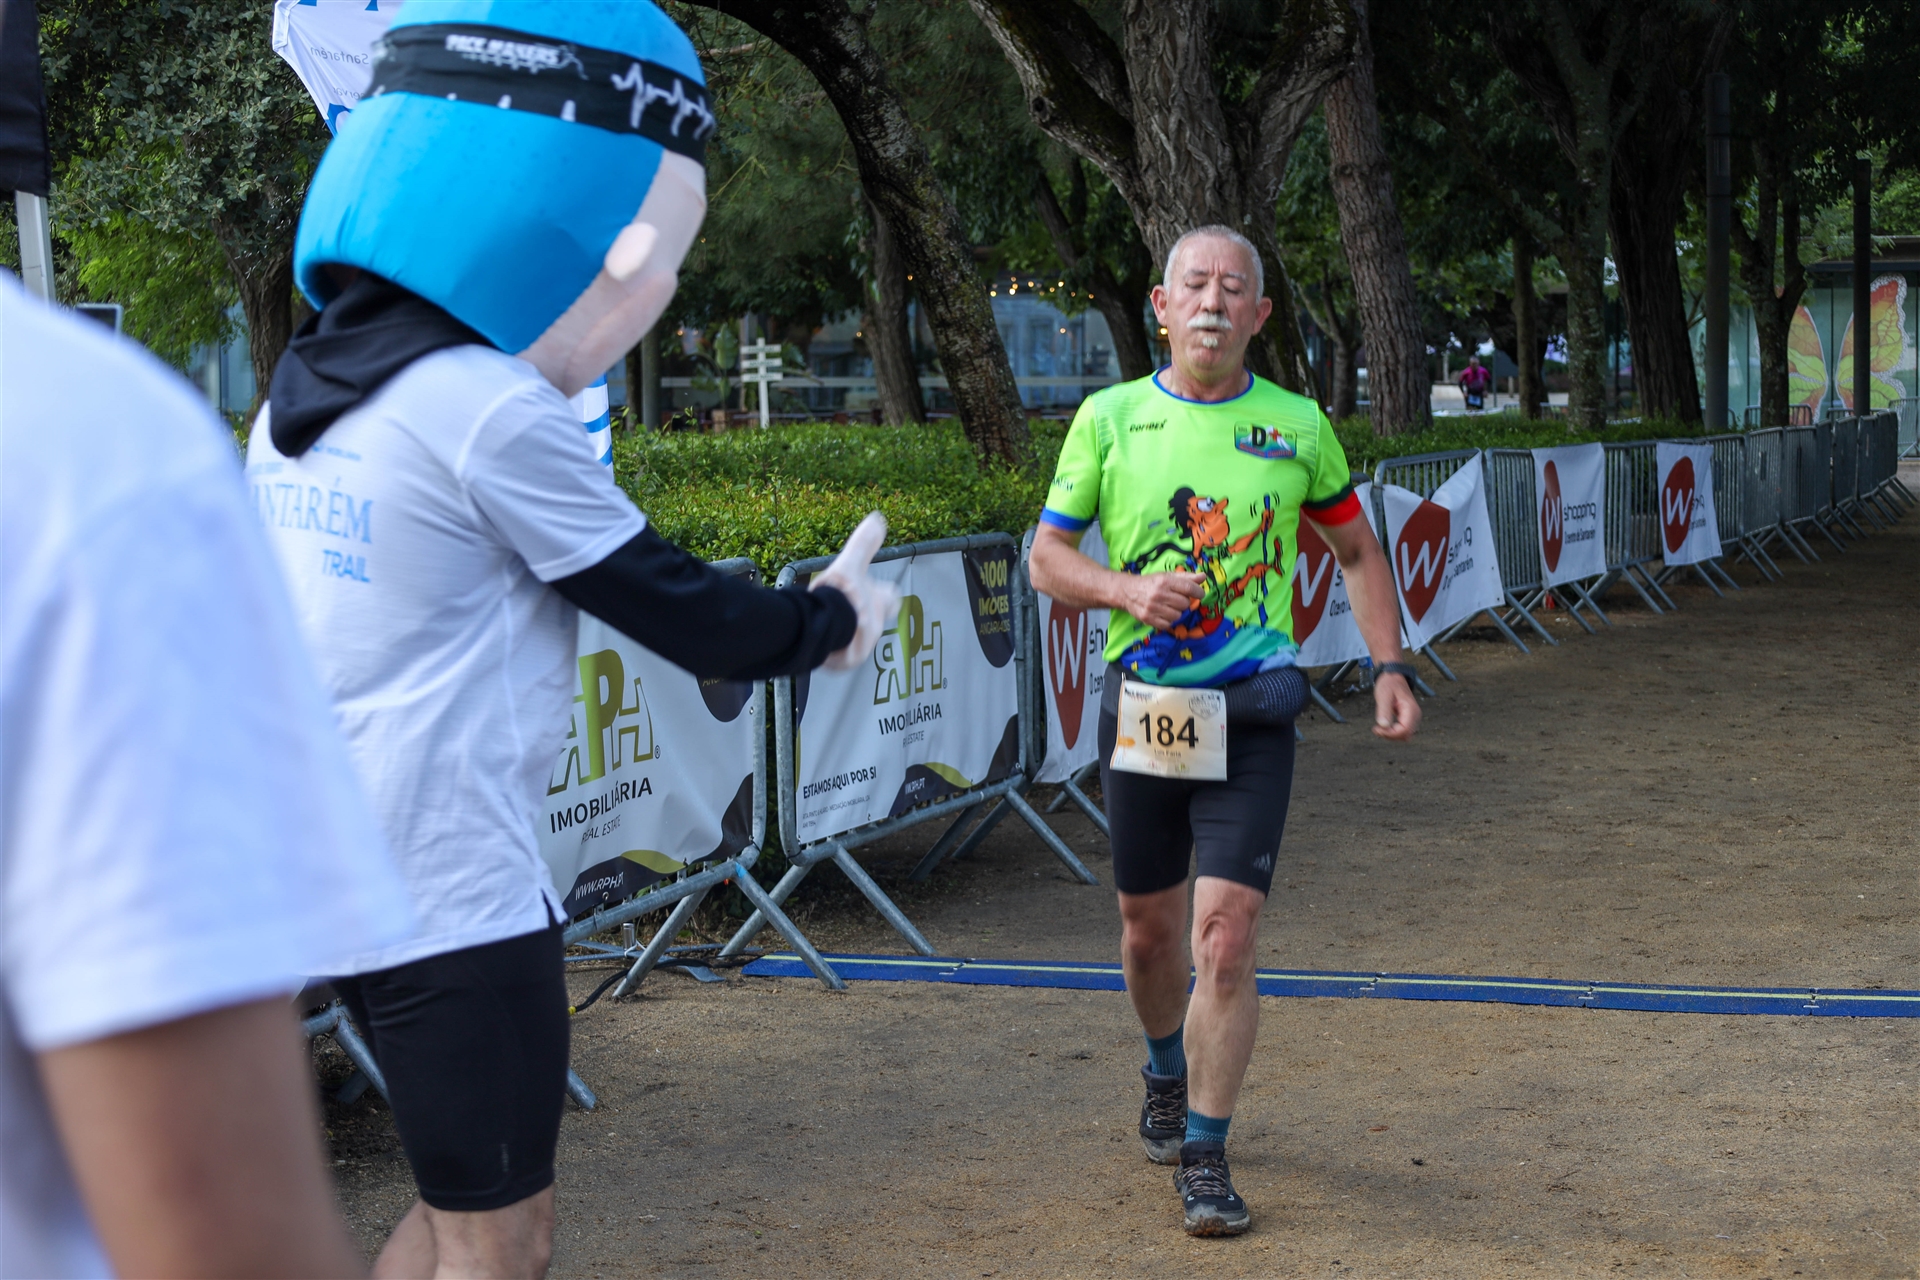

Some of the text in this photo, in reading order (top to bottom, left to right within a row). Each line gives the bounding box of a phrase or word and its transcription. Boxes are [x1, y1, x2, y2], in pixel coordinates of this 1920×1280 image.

[250, 476, 373, 544] ANTARÉM
[1564, 502, 1597, 522] shopping
[323, 549, 370, 583] TRAIL
[878, 702, 942, 735] IMOBILIÁRIA
[1139, 711, 1200, 750] 184
[803, 766, 877, 799] ESTAMOS AQUI POR SI
[550, 777, 653, 834] IMOBILIÁRIA
[581, 814, 621, 845] REAL ESTATE
